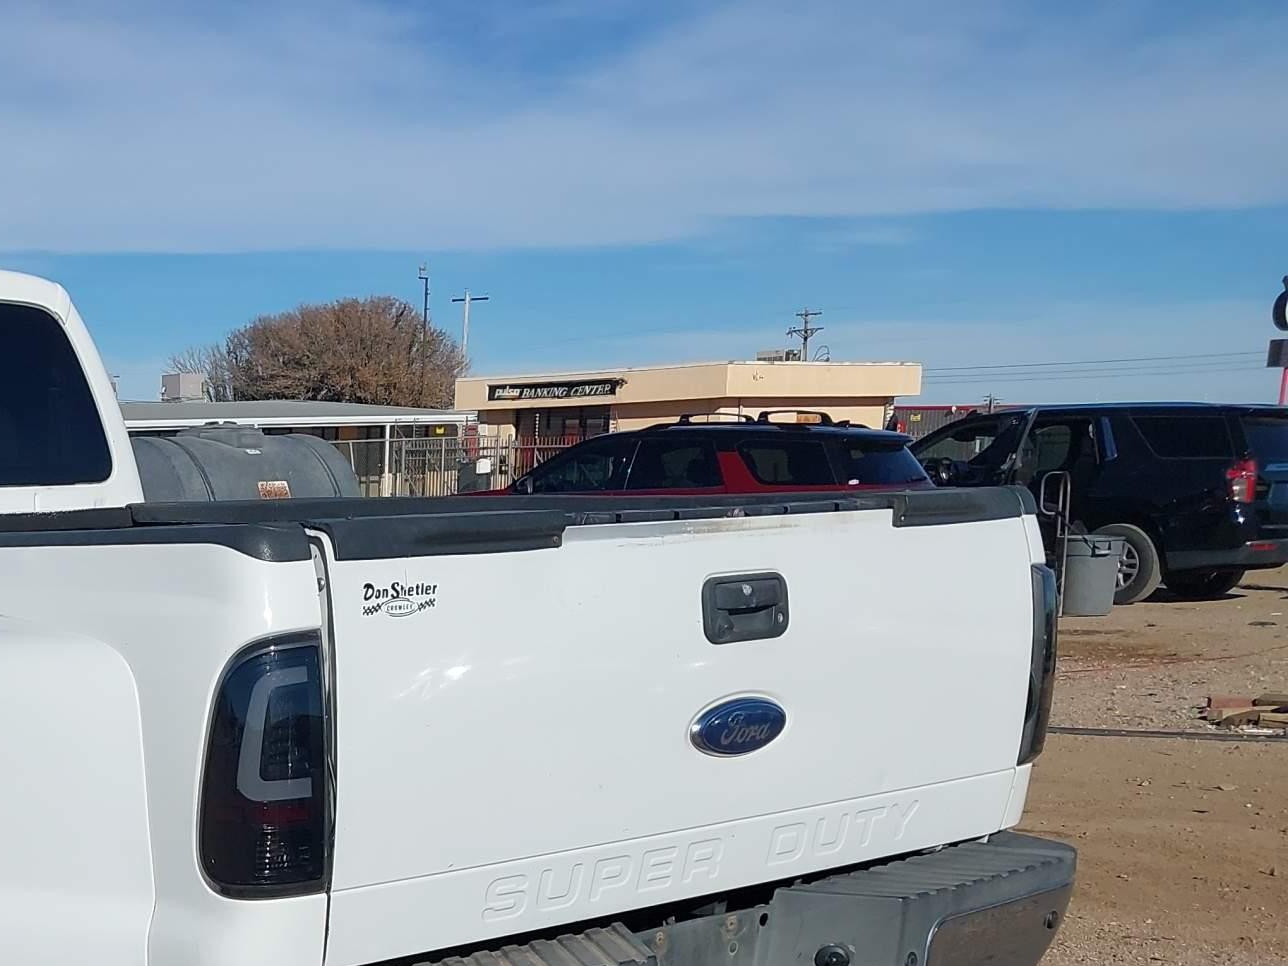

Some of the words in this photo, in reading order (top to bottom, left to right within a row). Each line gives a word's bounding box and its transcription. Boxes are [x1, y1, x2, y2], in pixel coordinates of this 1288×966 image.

[521, 386, 568, 398] BANKING
[570, 383, 612, 397] CENTER
[362, 582, 389, 602] Don
[720, 711, 770, 745] Ford
[481, 837, 722, 923] SUPER
[765, 798, 920, 868] DUTY
